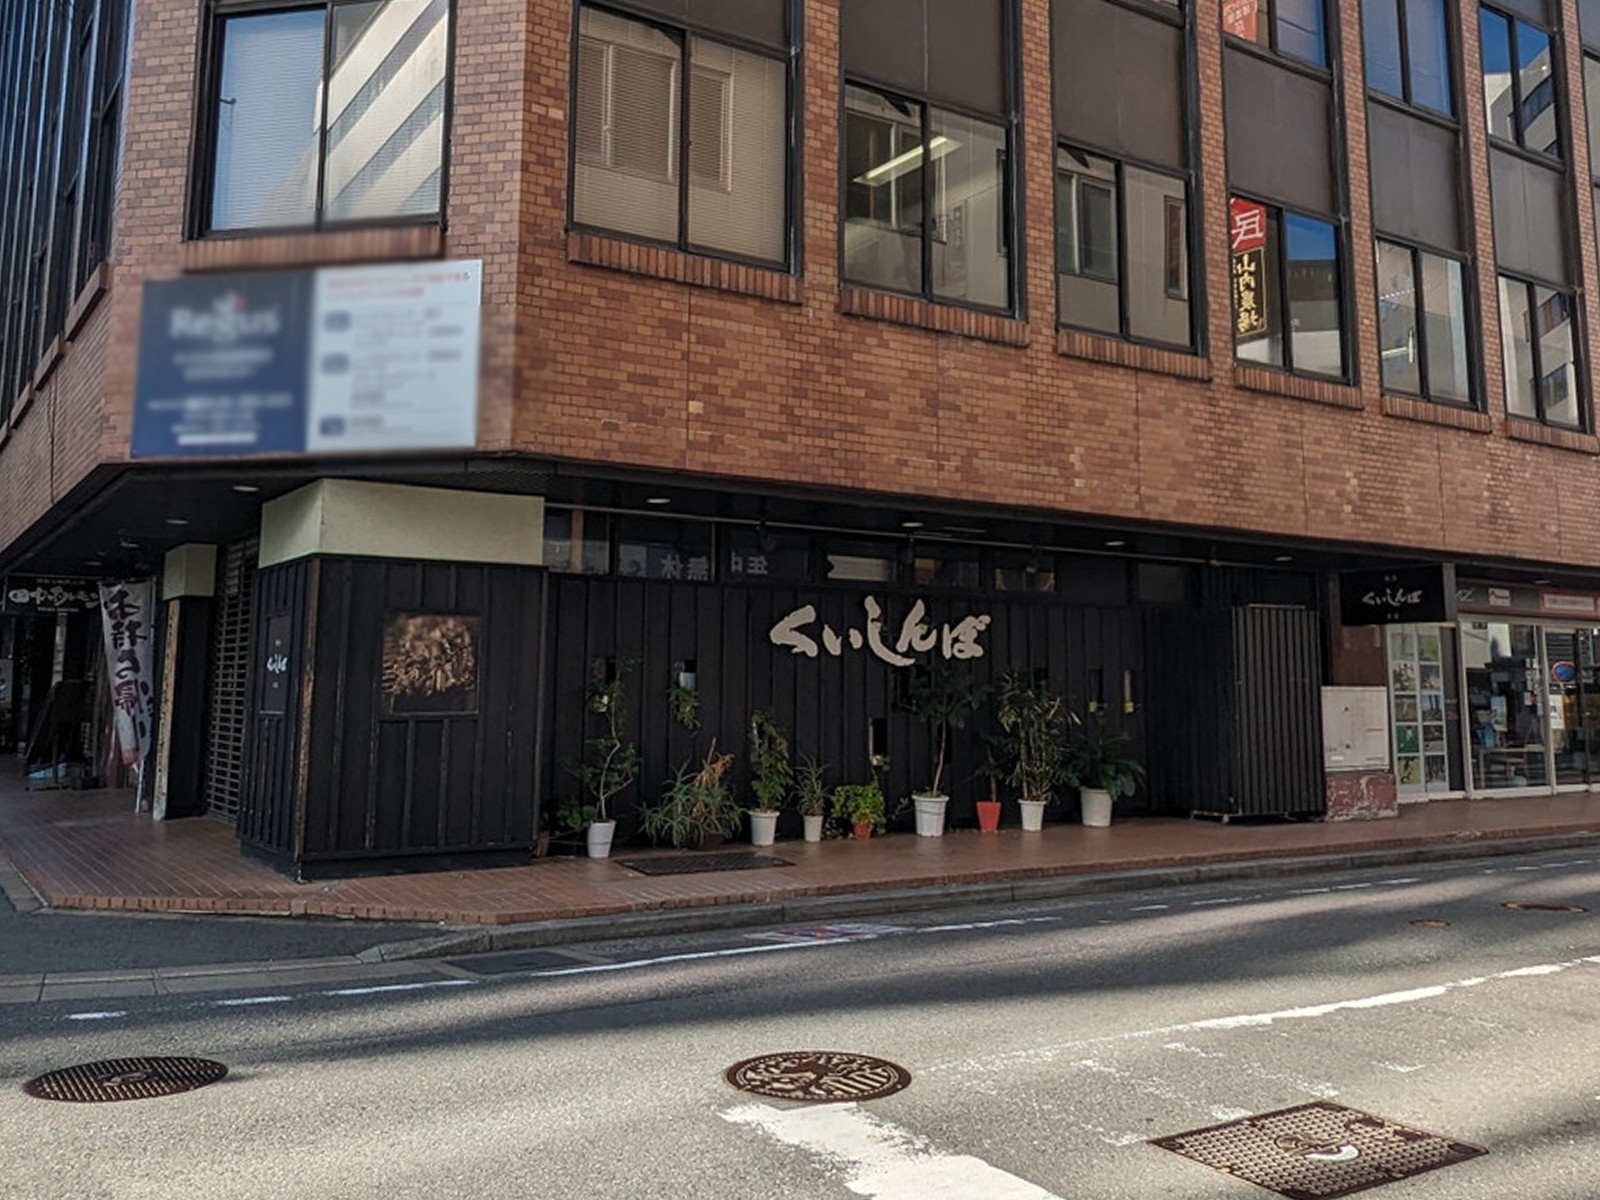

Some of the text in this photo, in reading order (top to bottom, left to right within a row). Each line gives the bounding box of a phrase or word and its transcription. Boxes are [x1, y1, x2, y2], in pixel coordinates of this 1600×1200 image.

[769, 594, 991, 667] くいしんぼ
